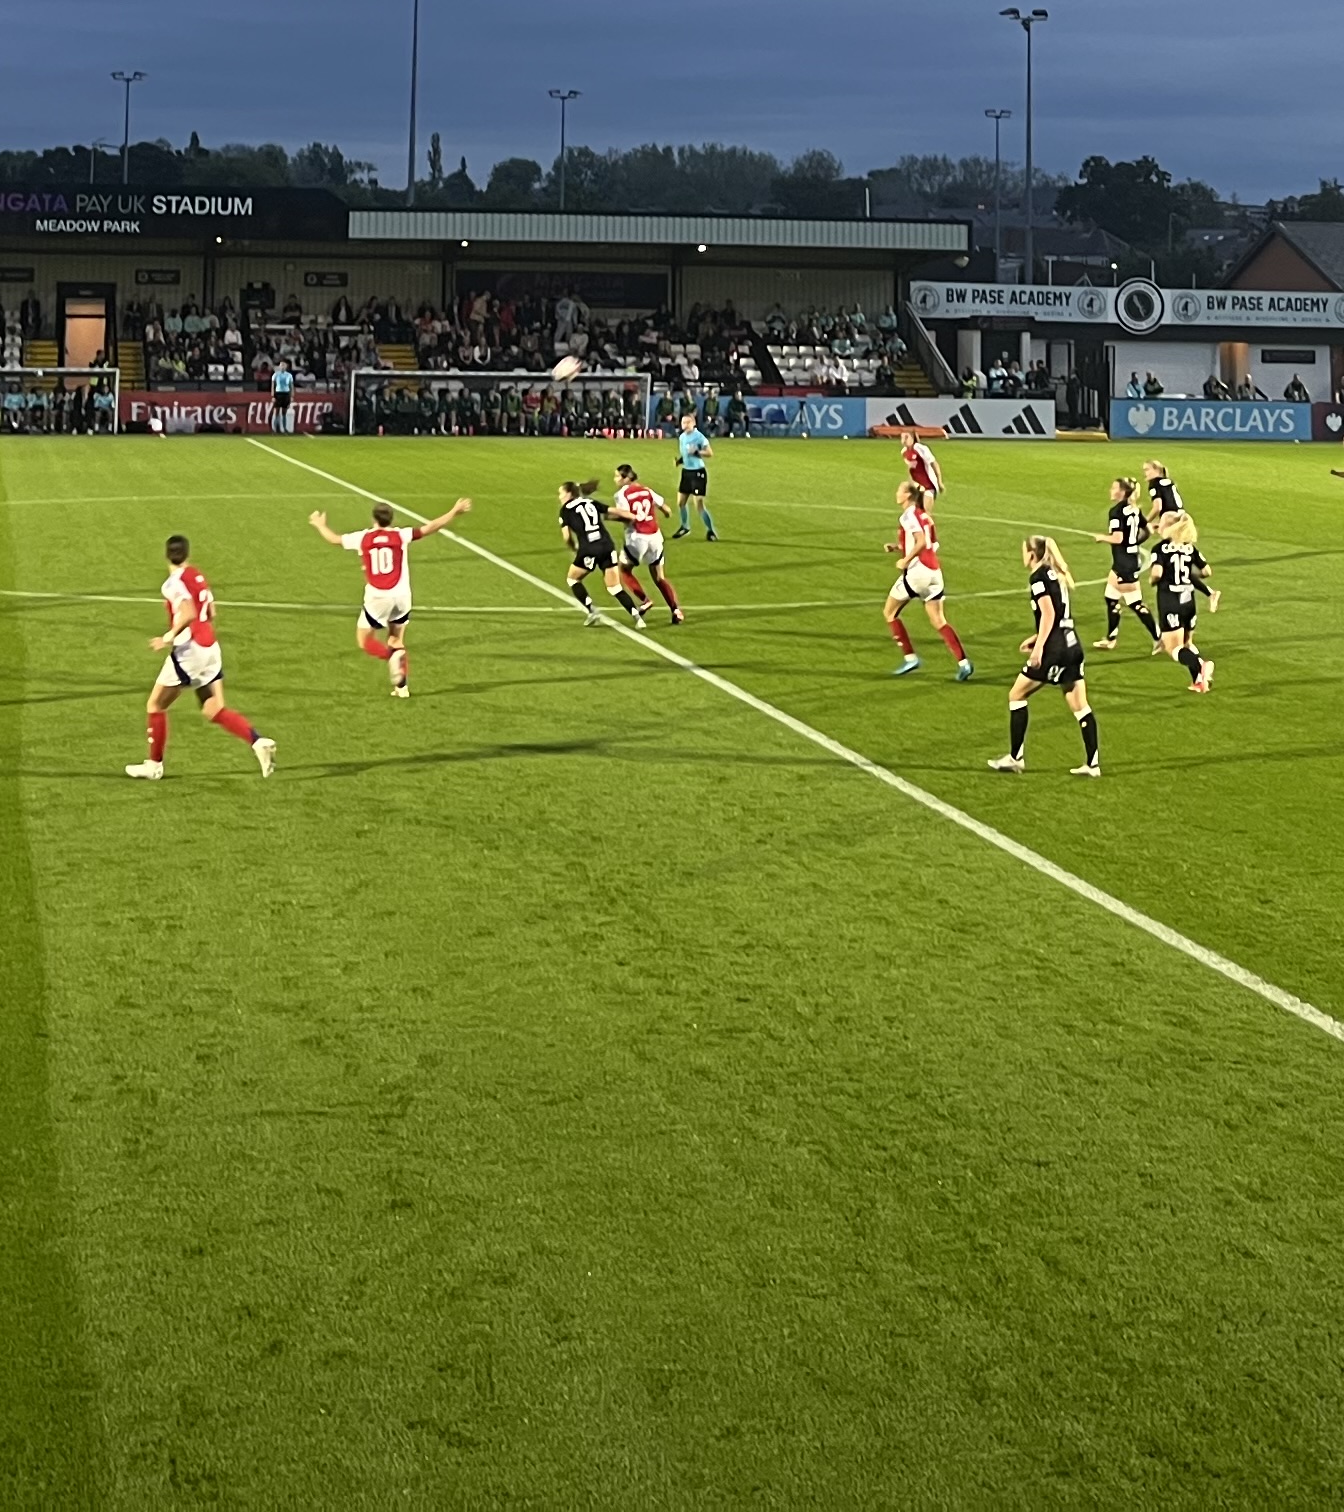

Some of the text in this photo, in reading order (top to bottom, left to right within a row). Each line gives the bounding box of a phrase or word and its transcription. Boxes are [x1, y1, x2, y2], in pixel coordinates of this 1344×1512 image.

[76, 193, 113, 213] PAY
[118, 194, 146, 214] UK
[152, 195, 253, 215] STADIUM
[35, 219, 141, 233] MEADOW PARK
[945, 288, 1072, 306] BW PASE ACADEMY
[1206, 295, 1329, 313] BW PASE ACADEMY
[1162, 407, 1295, 434] BARCLAYS
[575, 502, 600, 532] 19
[632, 498, 654, 522] 32
[368, 546, 394, 575] 10
[1169, 553, 1192, 585] 15
